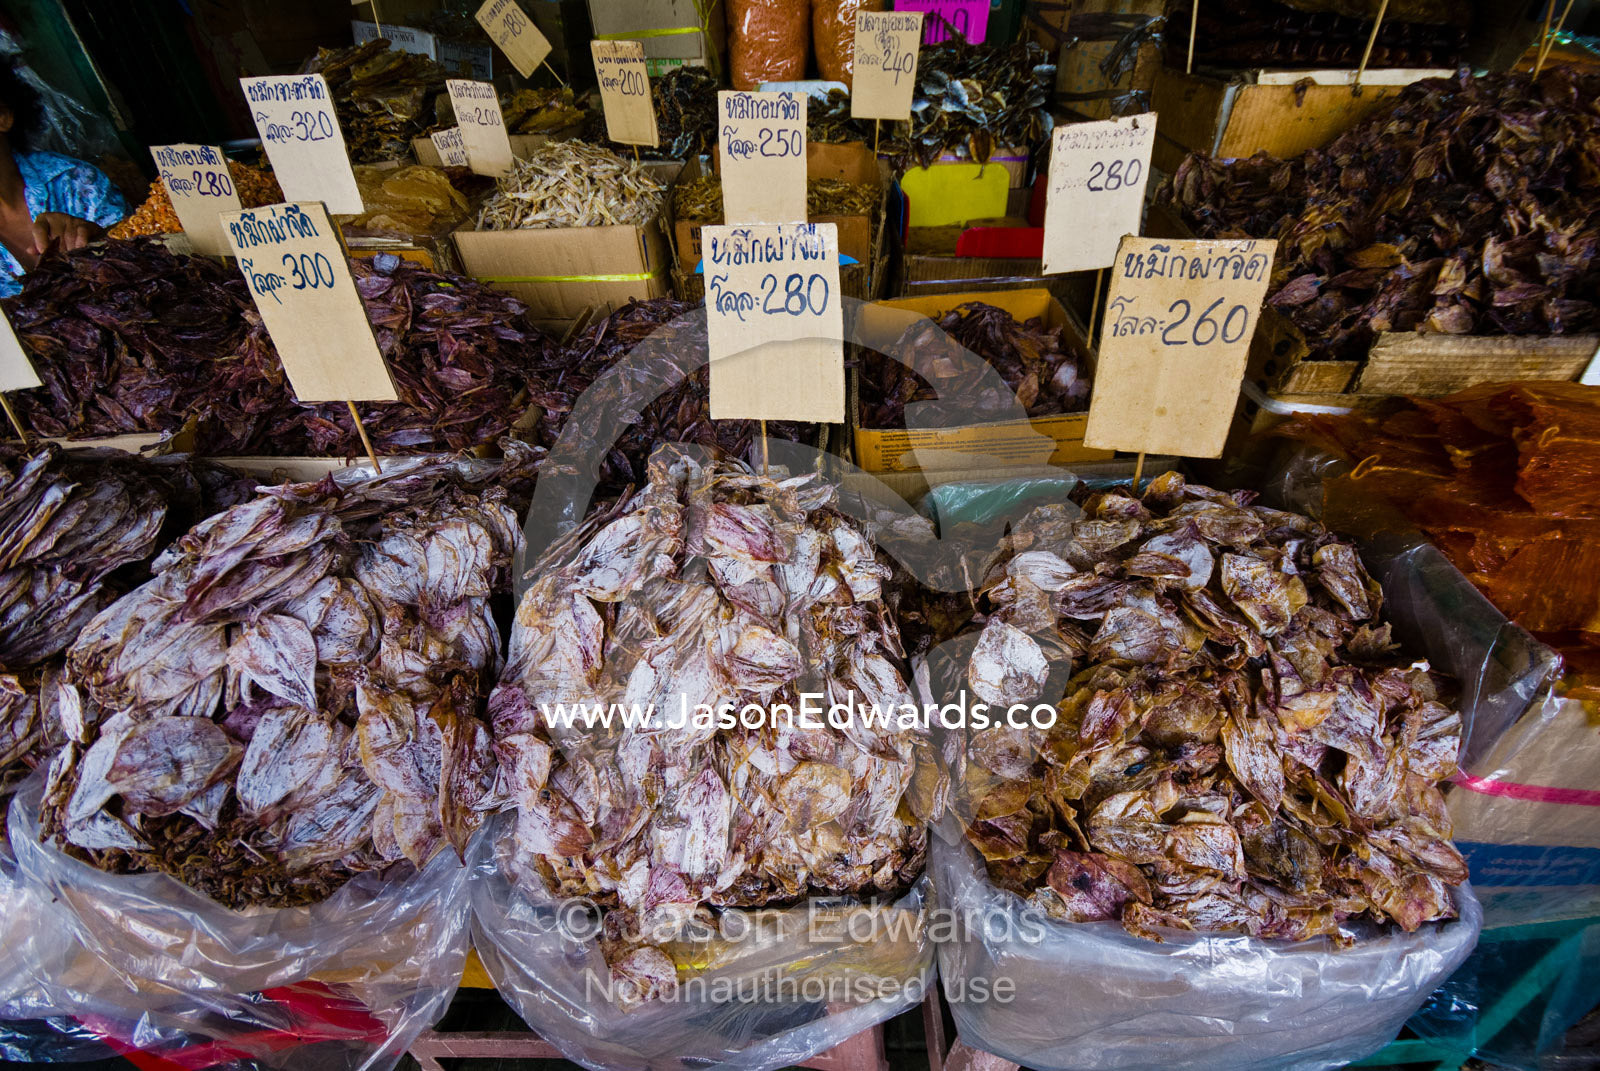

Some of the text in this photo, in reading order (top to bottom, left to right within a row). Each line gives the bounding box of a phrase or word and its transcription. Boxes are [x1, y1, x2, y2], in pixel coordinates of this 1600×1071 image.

[503, 8, 527, 37] 180
[619, 68, 645, 96] 200
[882, 48, 914, 86] 240
[291, 110, 334, 141] 320
[475, 107, 501, 126] 200
[758, 127, 802, 157] 250
[192, 170, 232, 197] 280
[1087, 158, 1142, 192] 280
[282, 252, 335, 290] 300
[760, 273, 829, 316] 280
[1162, 296, 1249, 346] 260
